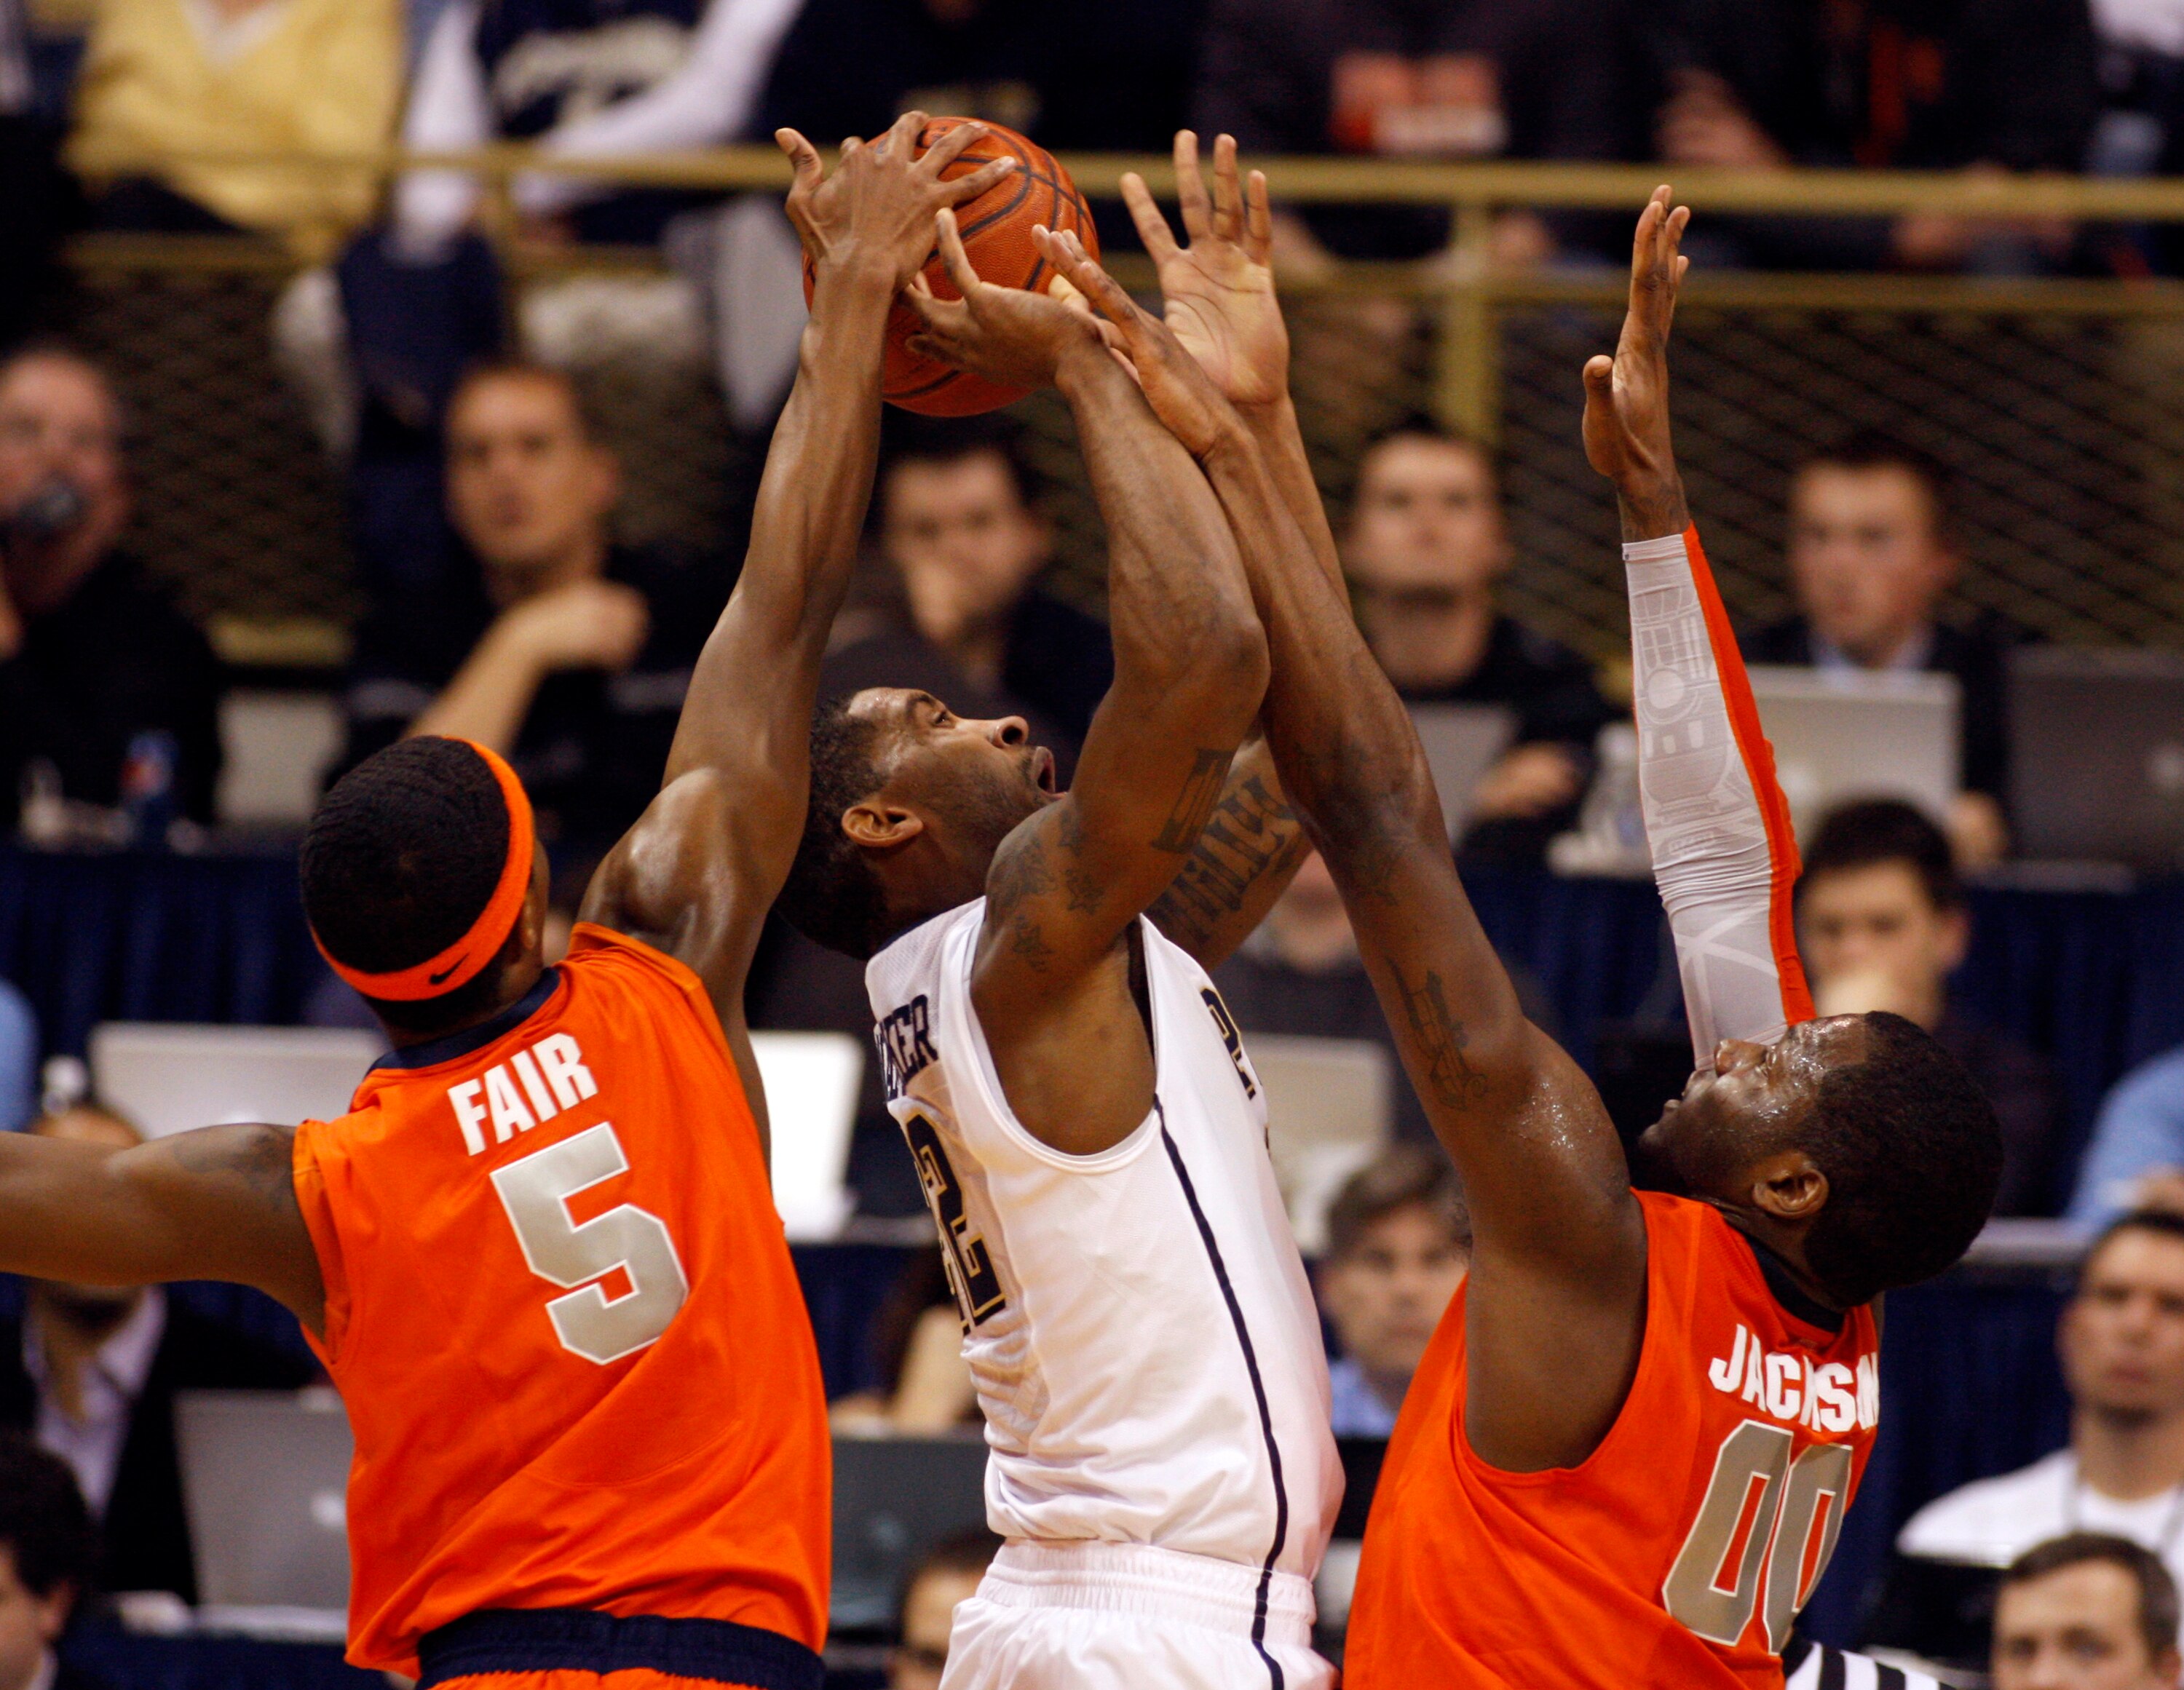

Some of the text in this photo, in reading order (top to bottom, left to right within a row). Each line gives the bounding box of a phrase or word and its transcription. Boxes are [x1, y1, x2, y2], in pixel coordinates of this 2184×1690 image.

[448, 1033, 598, 1156] FAIR
[490, 1122, 689, 1365] 5
[1662, 1419, 1853, 1656] 00
